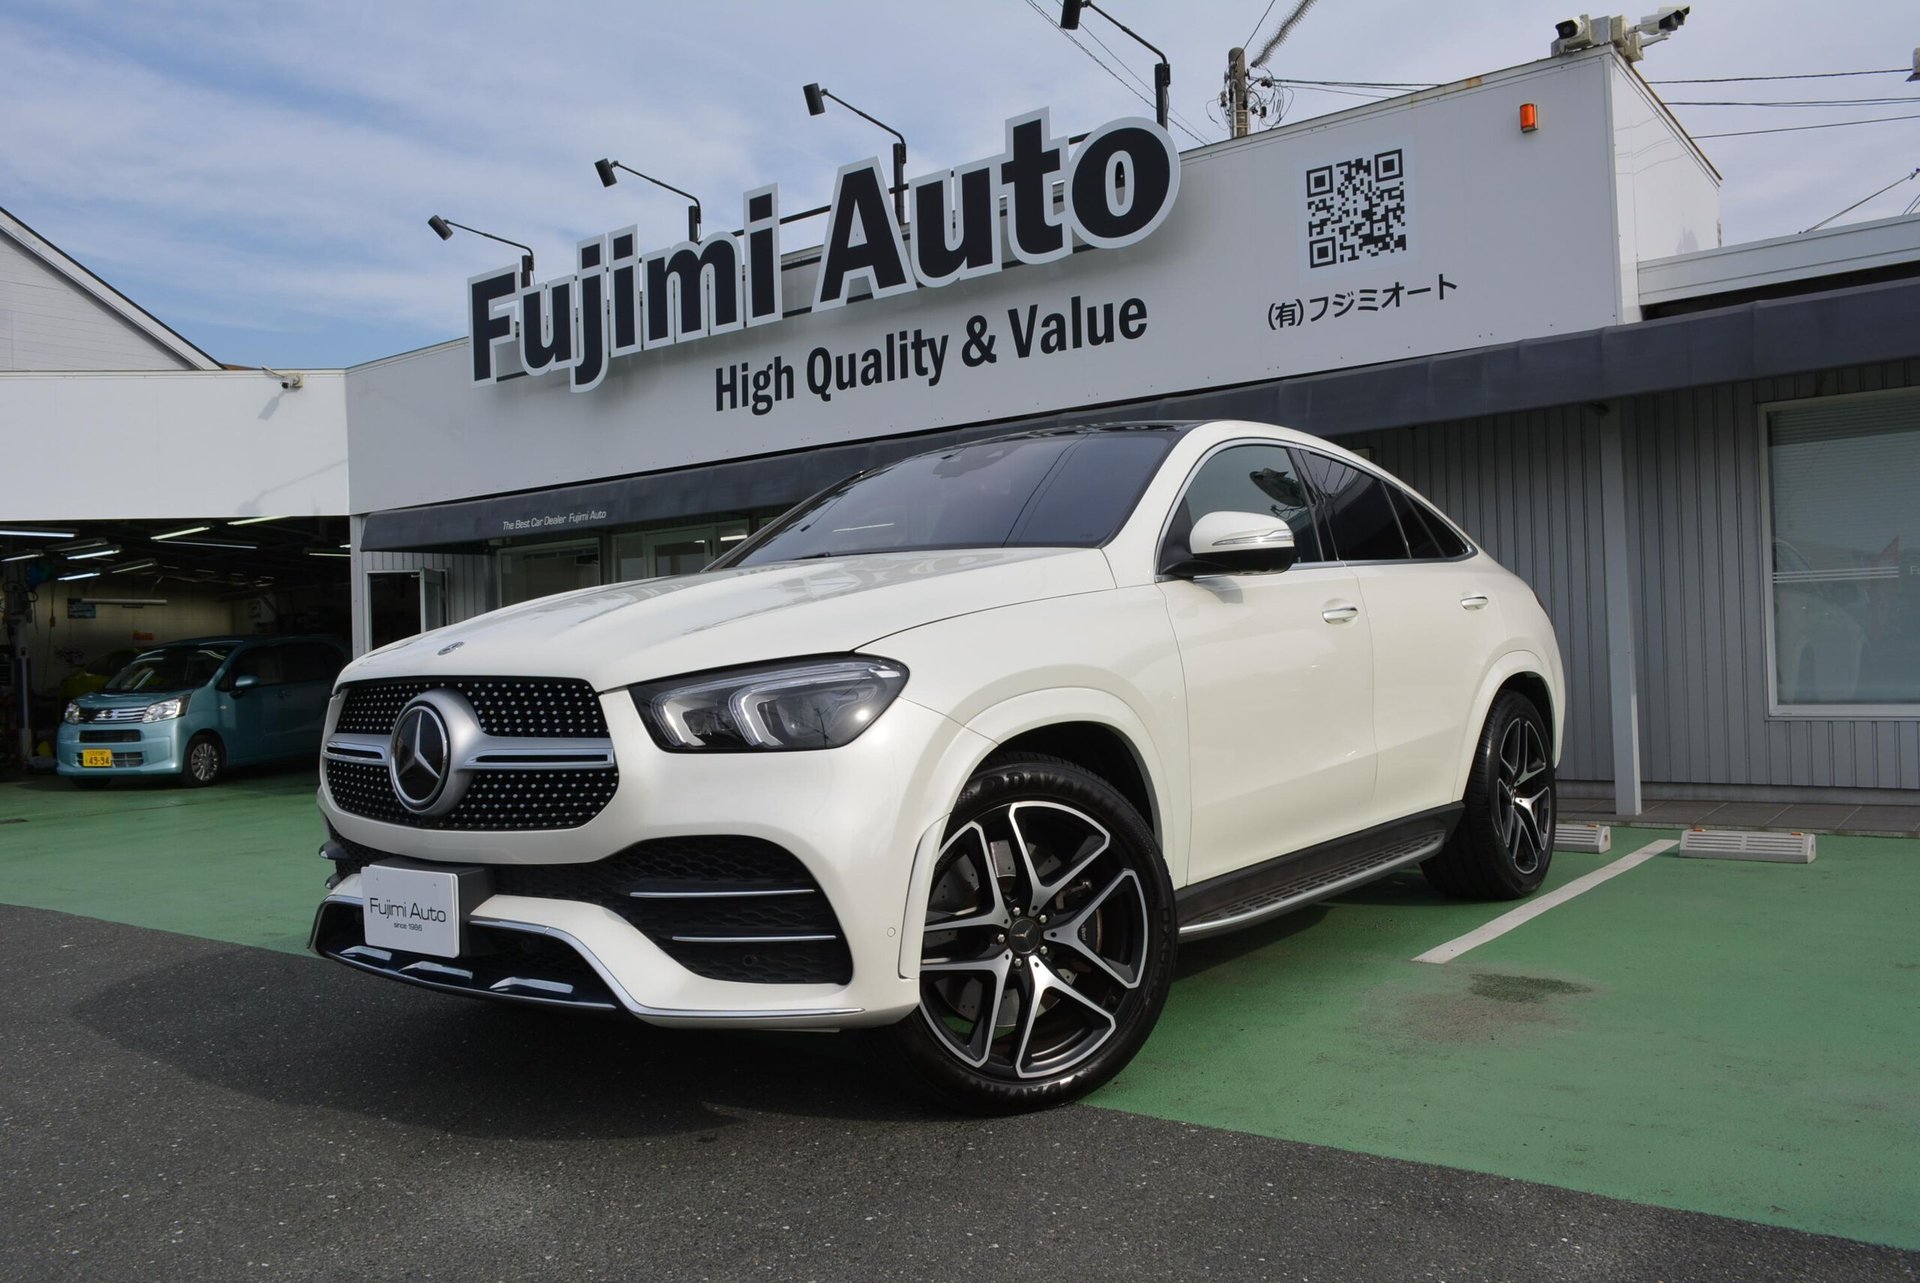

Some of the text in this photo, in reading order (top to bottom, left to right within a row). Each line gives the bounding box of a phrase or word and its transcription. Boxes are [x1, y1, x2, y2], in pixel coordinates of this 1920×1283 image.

[470, 112, 1176, 389] Fujimi Auto
[1267, 273, 1458, 331] (有)フジミオート
[714, 295, 1149, 417] High Quality & Value
[503, 509, 607, 531] The Best Car Dealer Fujimi Auto
[369, 897, 447, 923] Fujimi Auto
[393, 922, 407, 930] since
